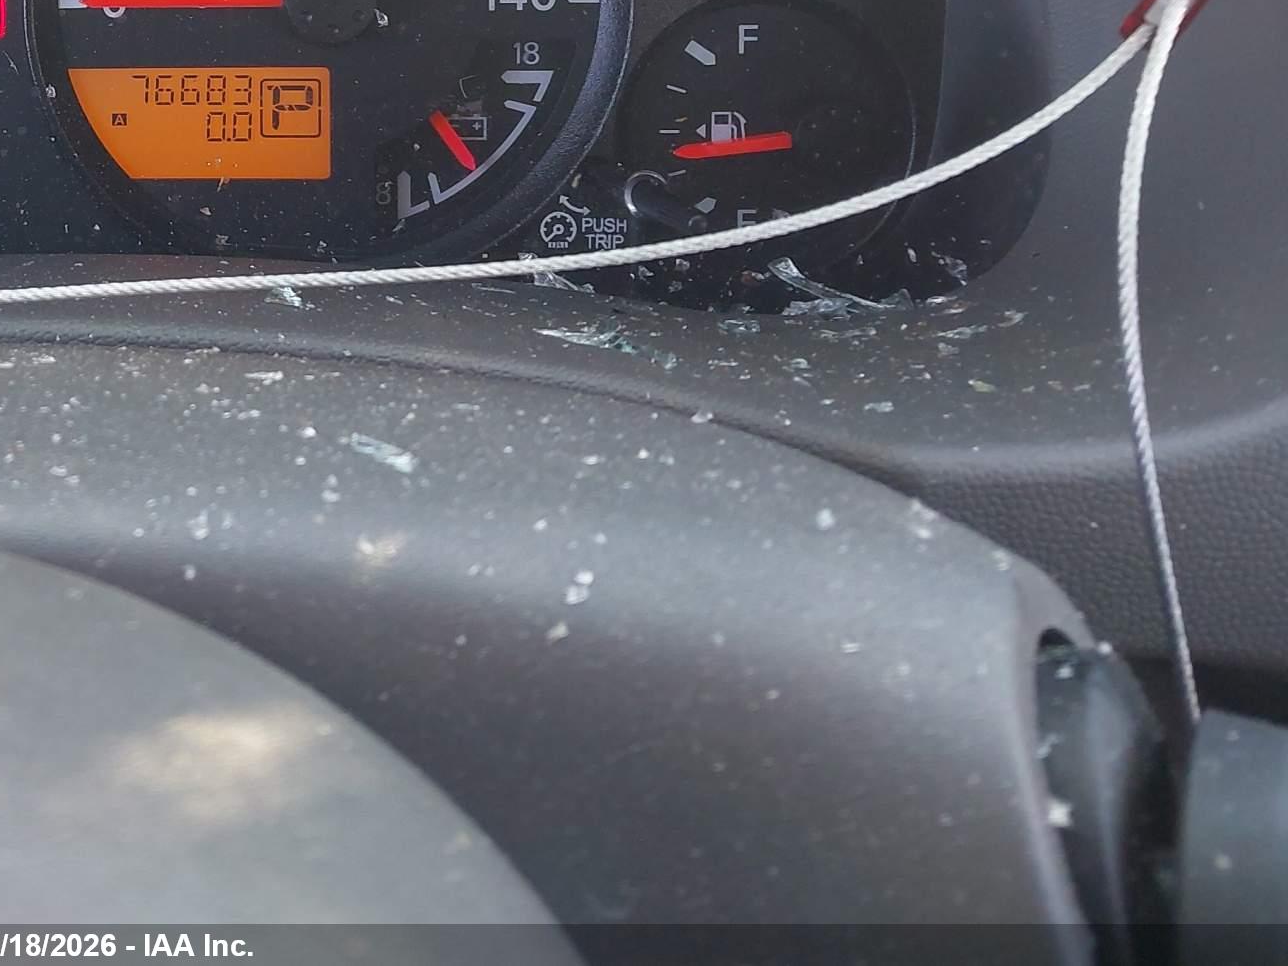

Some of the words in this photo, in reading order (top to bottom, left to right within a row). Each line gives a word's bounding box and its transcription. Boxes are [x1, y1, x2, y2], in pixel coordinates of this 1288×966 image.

[738, 25, 759, 54] F
[513, 42, 540, 65] 18
[131, 75, 253, 106] 76683
[112, 113, 127, 126] A
[267, 85, 314, 131] P
[206, 111, 253, 142] 0.0
[582, 218, 627, 233] PUSH
[585, 234, 624, 249] TRIP
